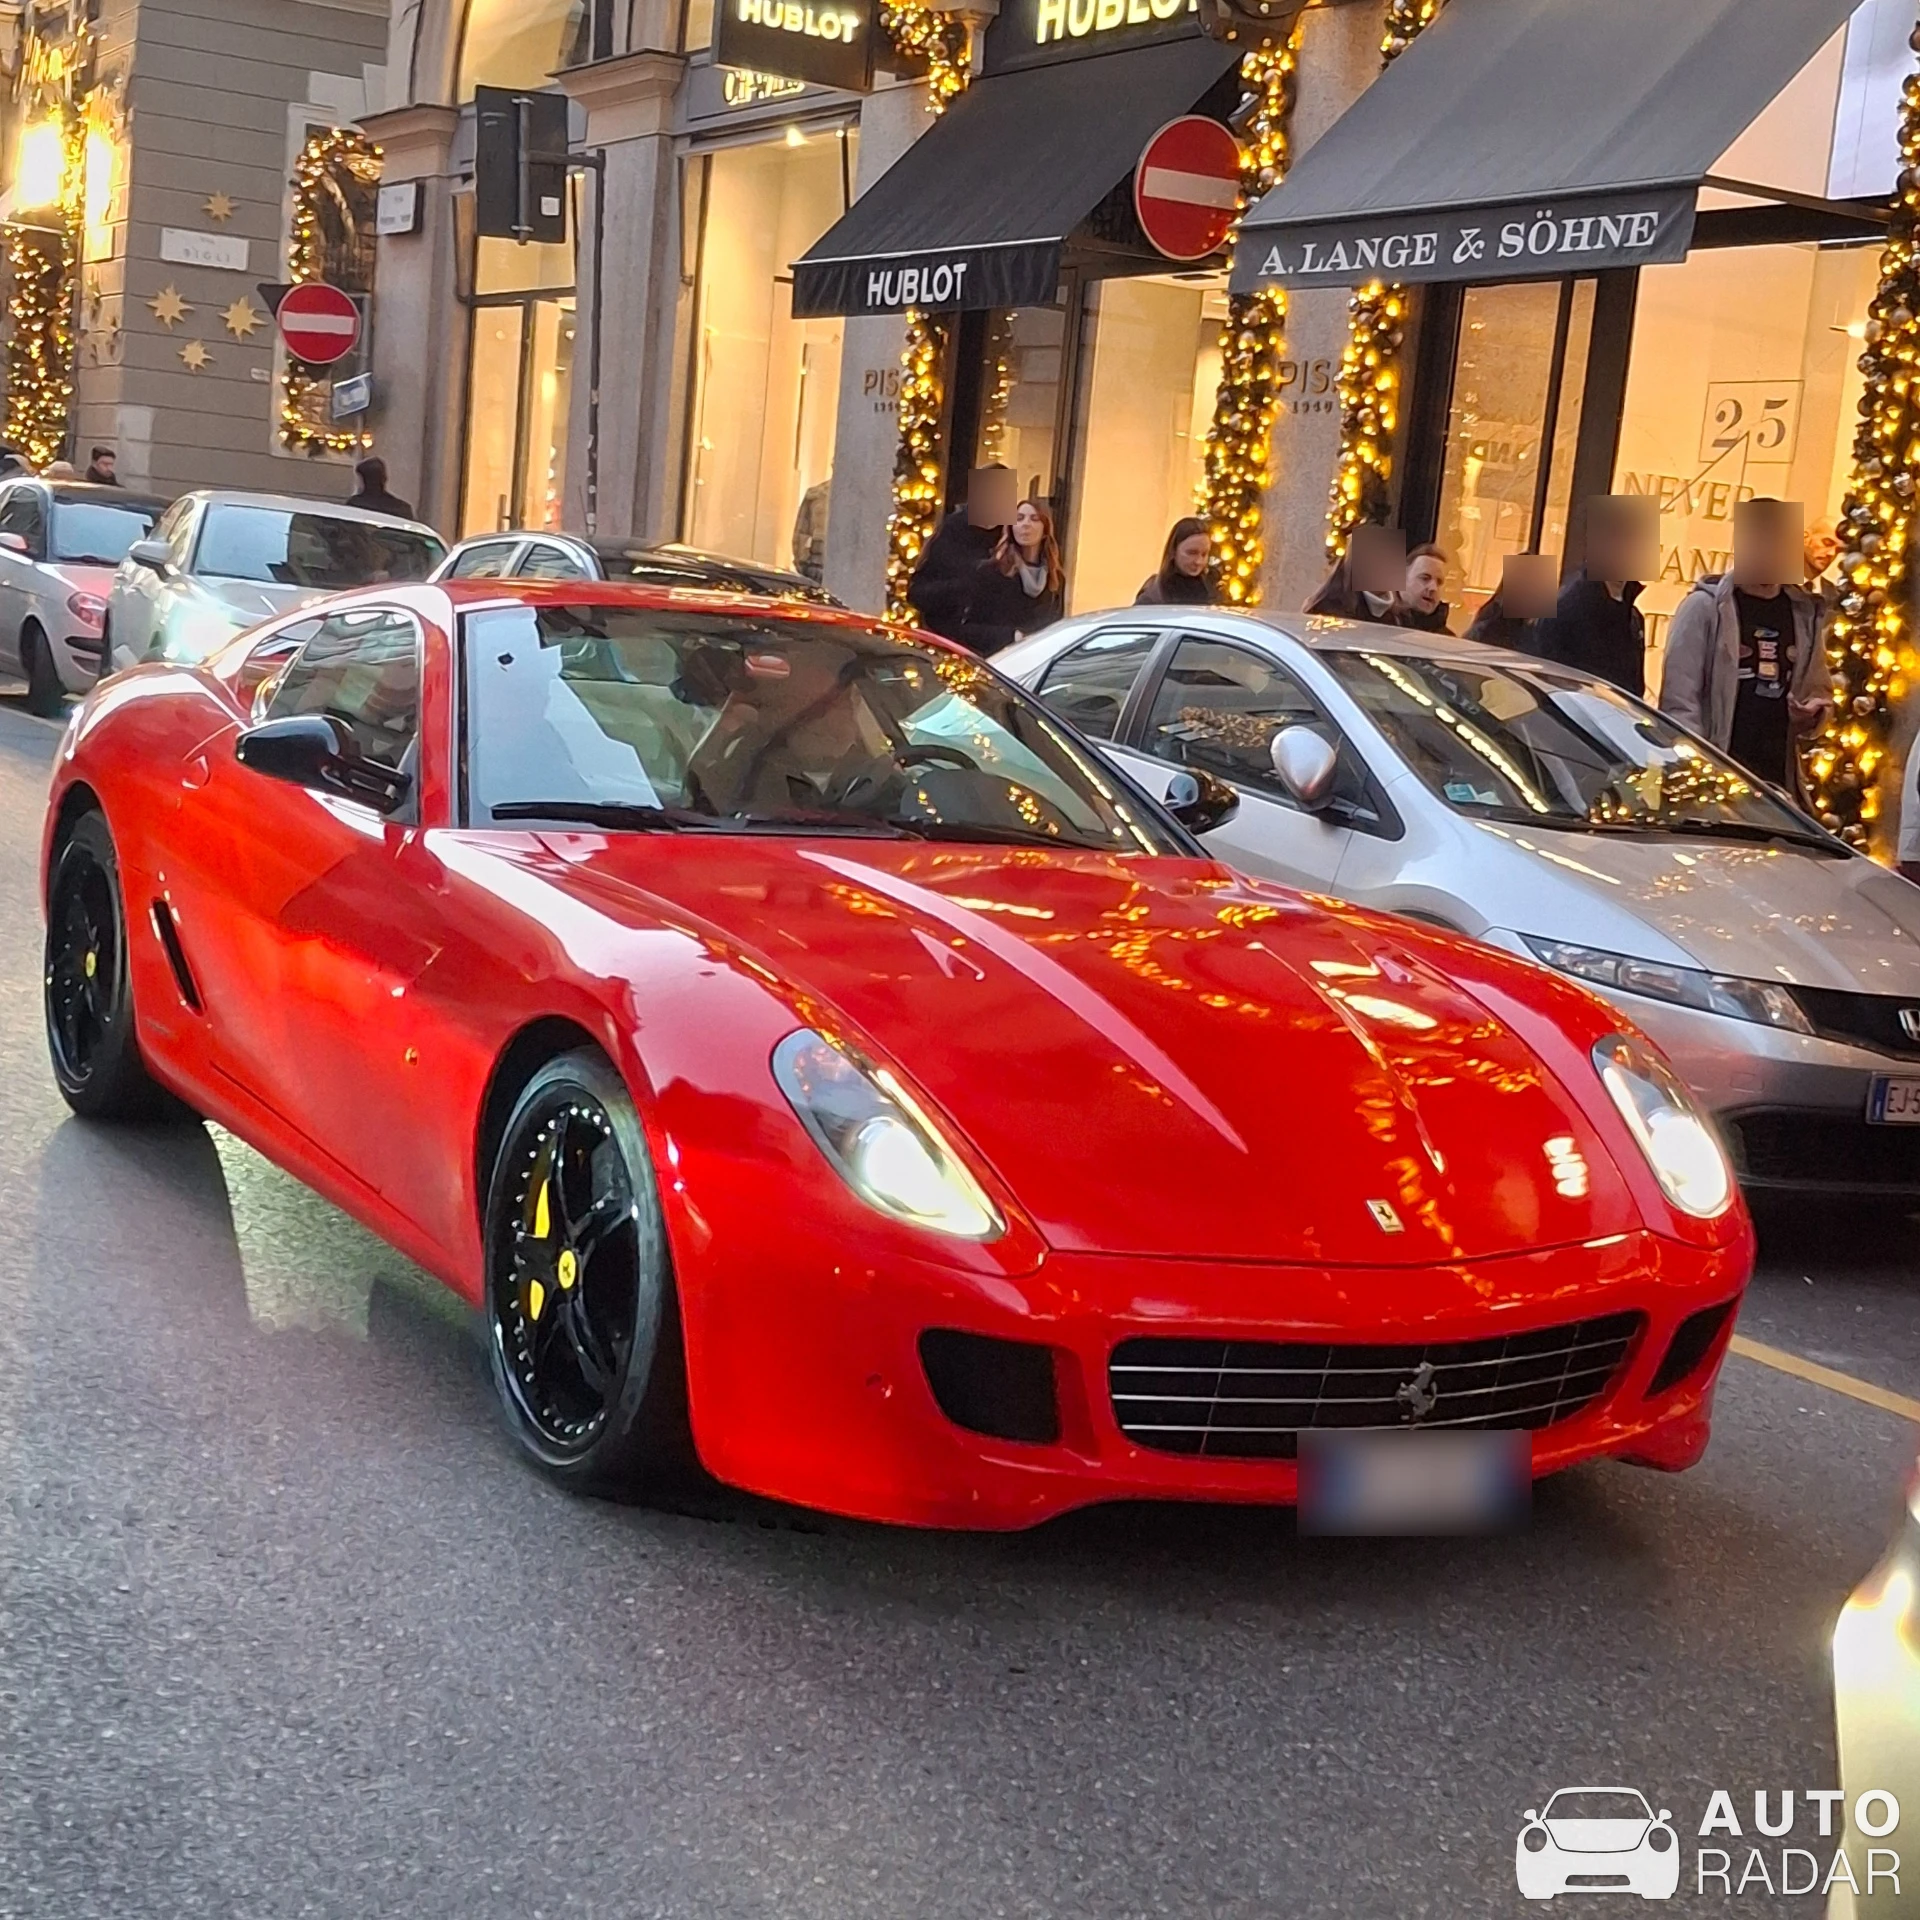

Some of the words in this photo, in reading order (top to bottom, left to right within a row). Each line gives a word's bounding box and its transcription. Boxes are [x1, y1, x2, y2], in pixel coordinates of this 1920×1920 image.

[738, 0, 859, 43] HUBLOT
[1036, 0, 1198, 44] HUBL
[1452, 228, 1485, 264] &
[1497, 210, 1659, 258] SÖHNE
[867, 263, 967, 306] HUBLOT
[864, 367, 900, 397] PIS
[1276, 359, 1338, 393] PIS
[1711, 399, 1788, 448] 25
